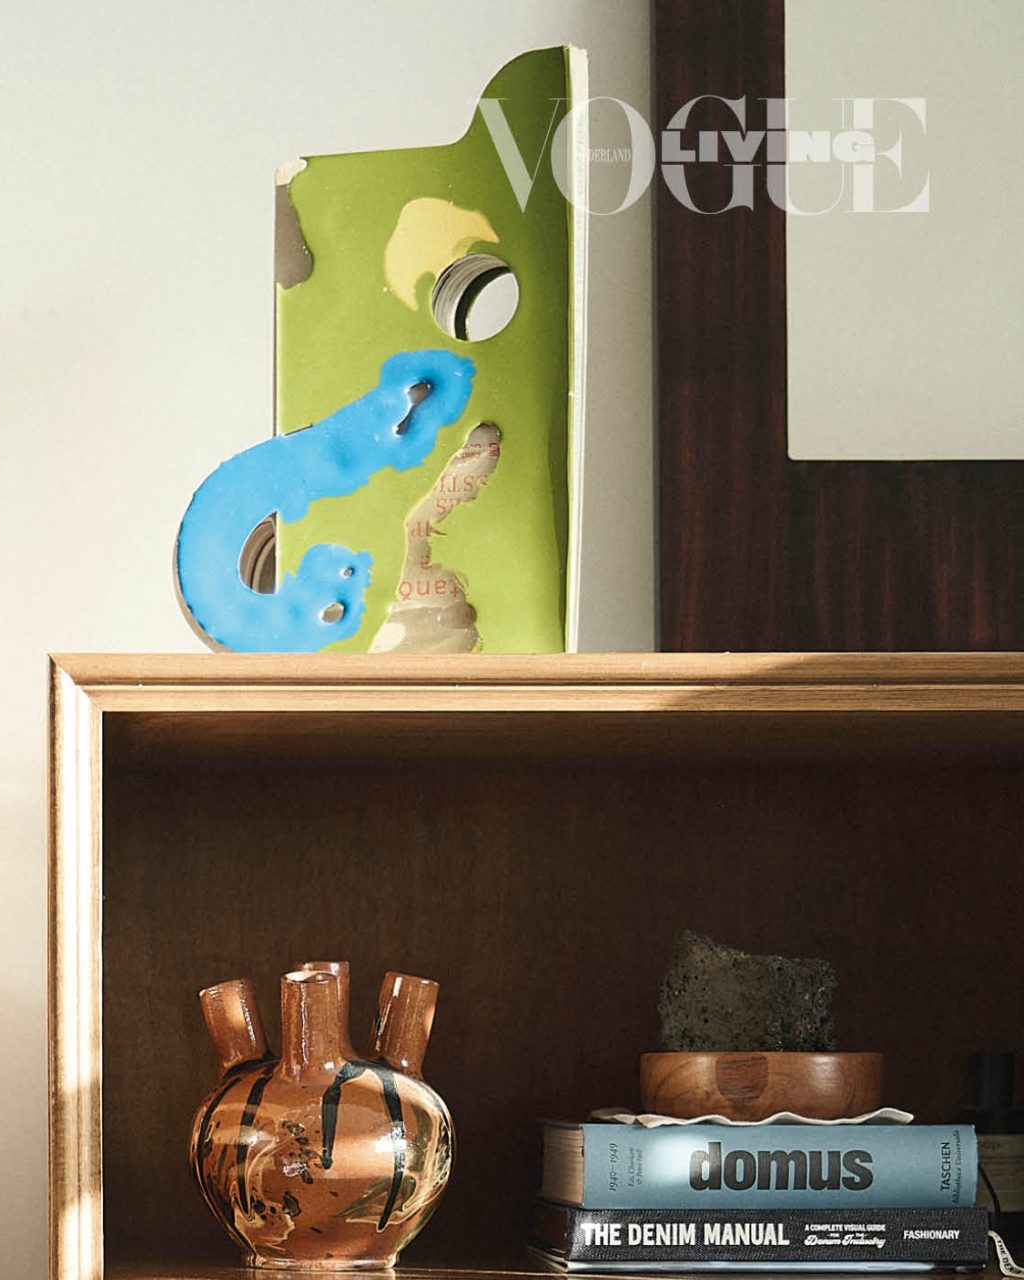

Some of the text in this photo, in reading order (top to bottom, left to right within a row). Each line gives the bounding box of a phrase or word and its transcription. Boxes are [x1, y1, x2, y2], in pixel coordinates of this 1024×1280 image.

[689, 1142, 874, 1192] domus
[940, 1142, 951, 1191] TASCHEN
[580, 1222, 790, 1246] THE DENIM MANUAL
[805, 1224, 886, 1232] A COMPLETE VISUAL GUIDE
[903, 1230, 960, 1240] FASHIONARY
